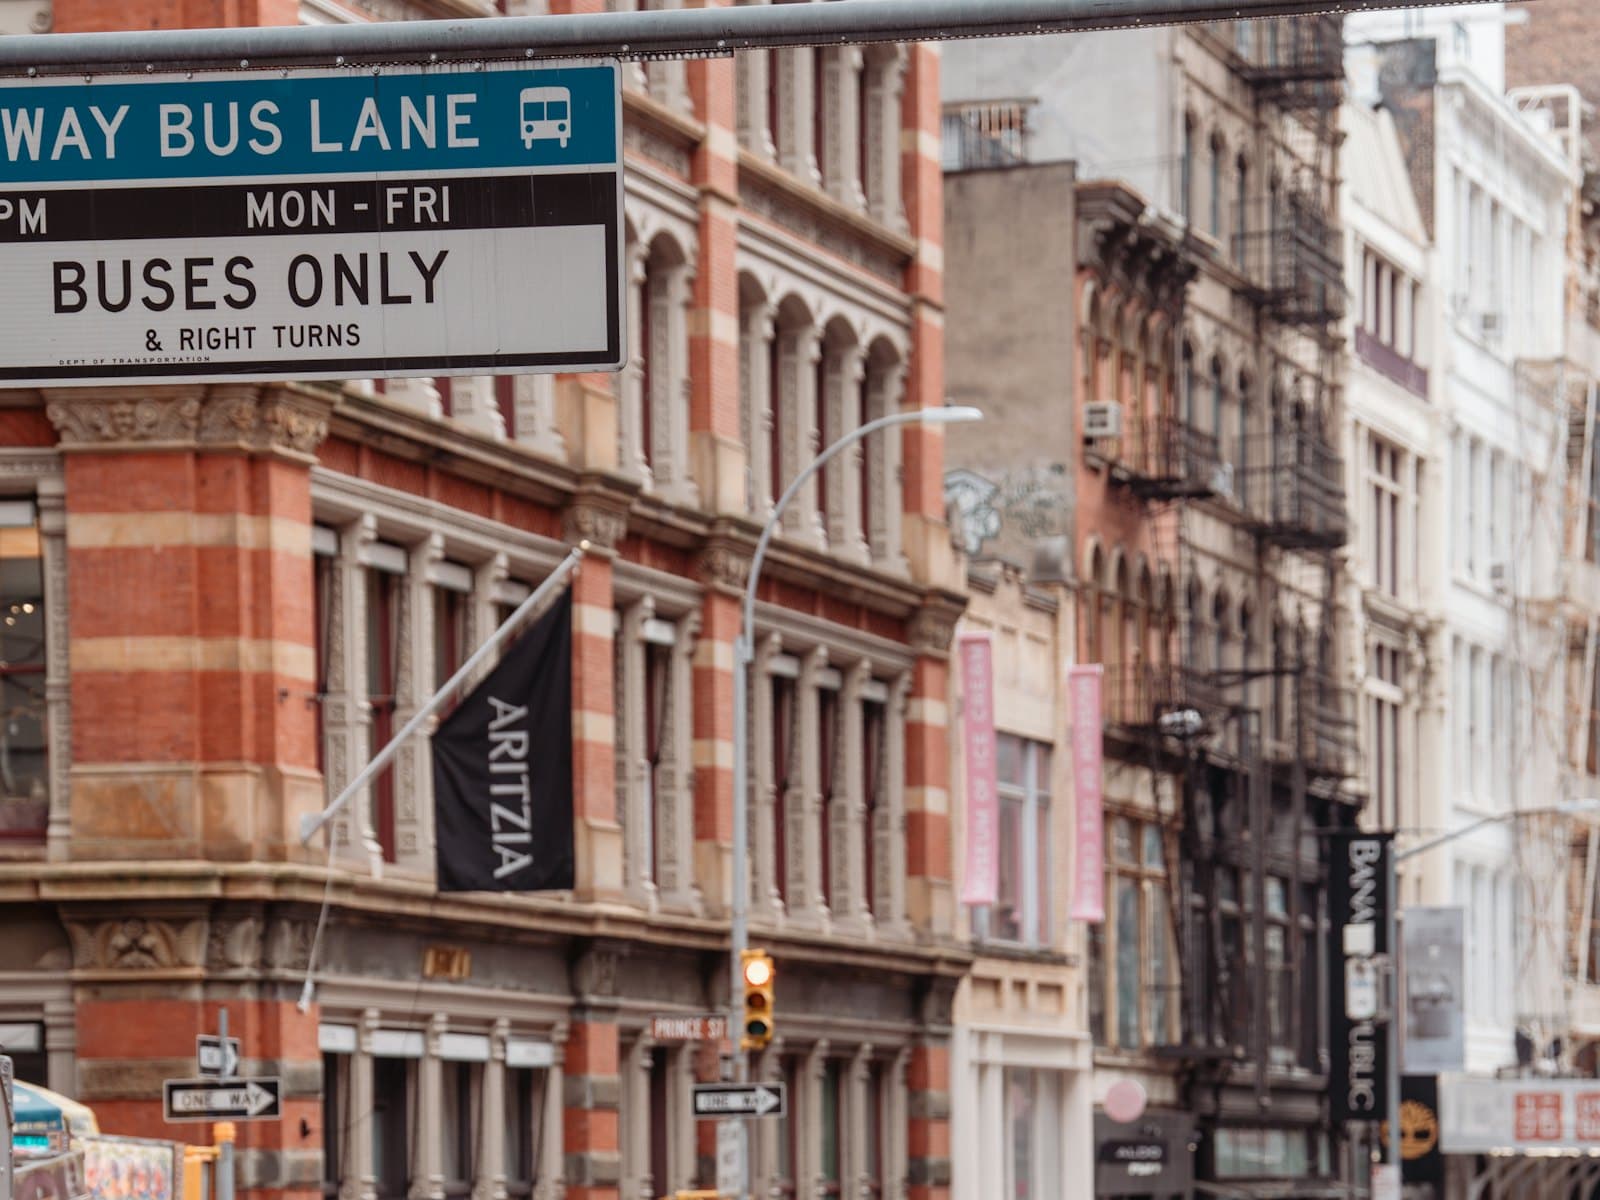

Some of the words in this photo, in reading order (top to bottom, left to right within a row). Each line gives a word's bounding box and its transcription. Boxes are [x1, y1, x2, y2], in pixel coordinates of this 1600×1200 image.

[1, 105, 130, 161] WAY
[159, 101, 283, 158] BUS
[311, 93, 479, 152] LANE
[0, 198, 47, 235] PM
[247, 188, 336, 229] MON
[386, 186, 451, 224] FRI
[53, 256, 257, 314] BUSES
[288, 250, 449, 308] ONLY
[145, 329, 163, 352] &
[180, 326, 256, 351] RIGHT
[273, 324, 360, 348] TURNS
[112, 356, 211, 364] TRANSPORTATION
[970, 645, 987, 723] CREAM
[973, 732, 989, 768] ICE
[487, 695, 534, 880] ARITZIA
[1348, 840, 1381, 925] BANA
[654, 1017, 702, 1040] PRINCE
[182, 1094, 212, 1107] ONE
[229, 1093, 261, 1105] WAY
